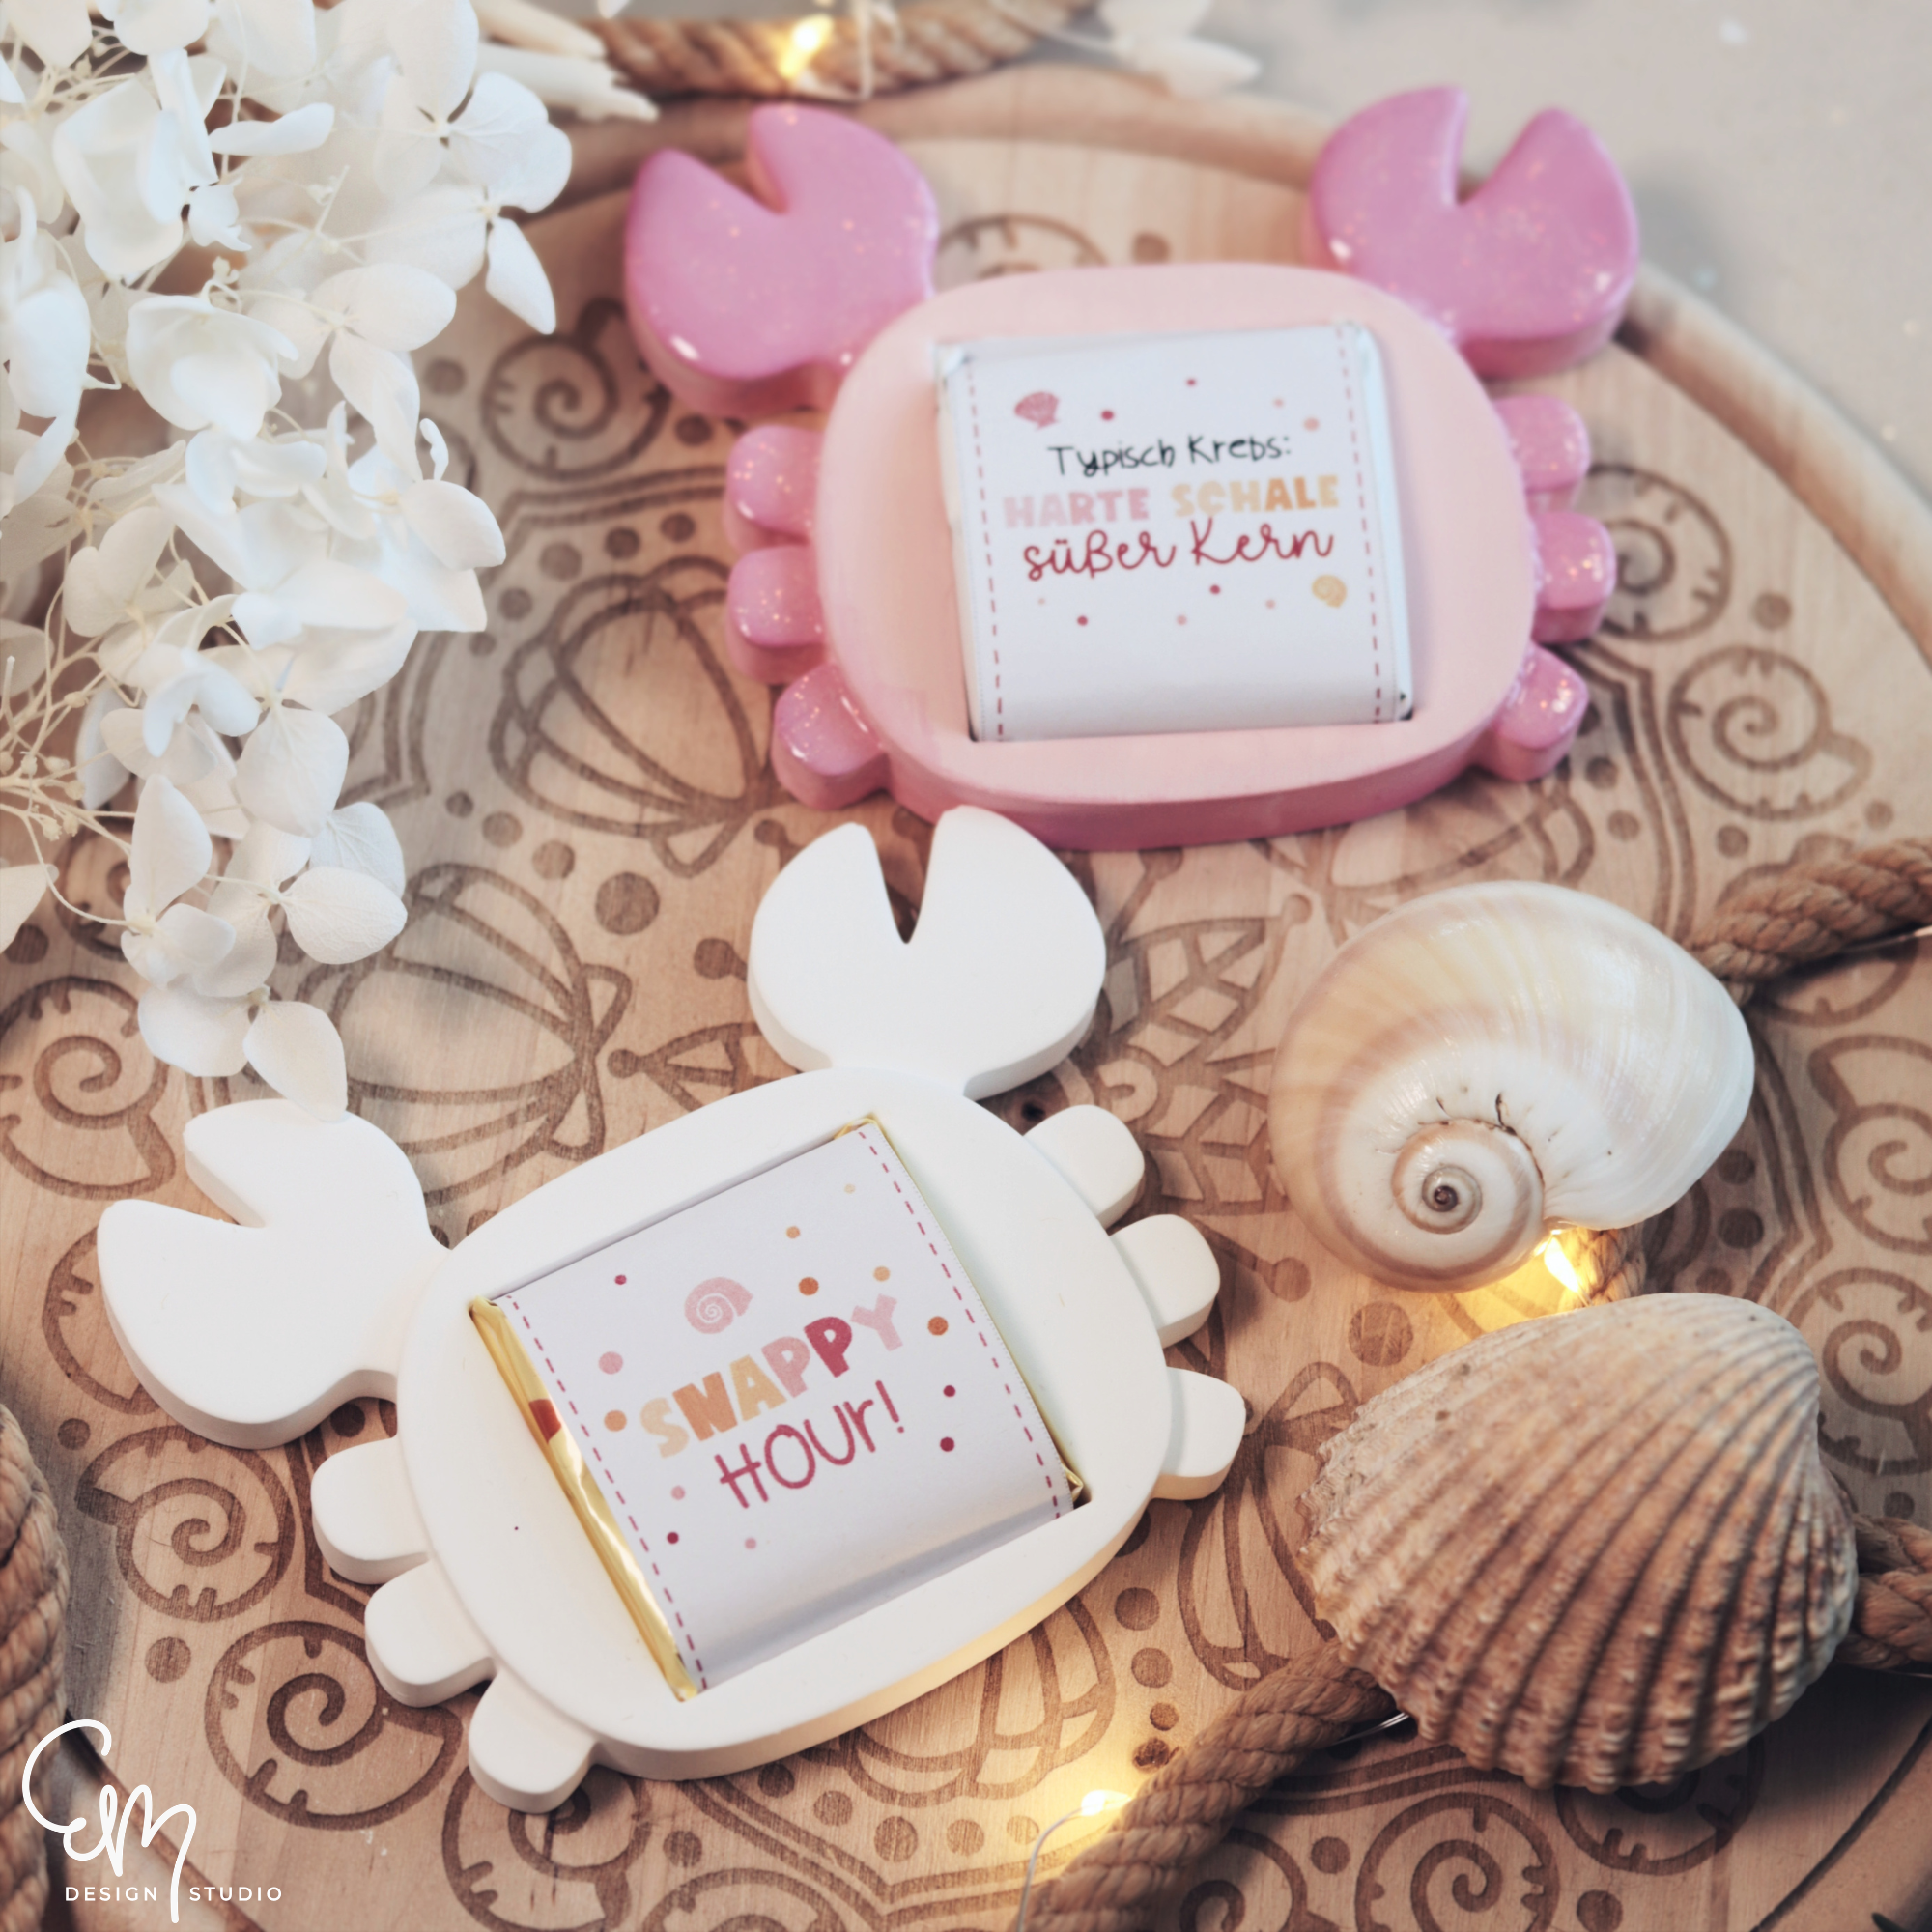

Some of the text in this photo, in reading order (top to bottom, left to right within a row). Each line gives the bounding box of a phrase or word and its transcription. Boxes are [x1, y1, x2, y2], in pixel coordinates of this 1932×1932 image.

[1048, 434, 1293, 477] Typisch Krebs:
[1003, 474, 1341, 528] HARTE SCHALE
[1023, 516, 1334, 581] süßer Kern
[639, 1293, 904, 1459] SNAPPY
